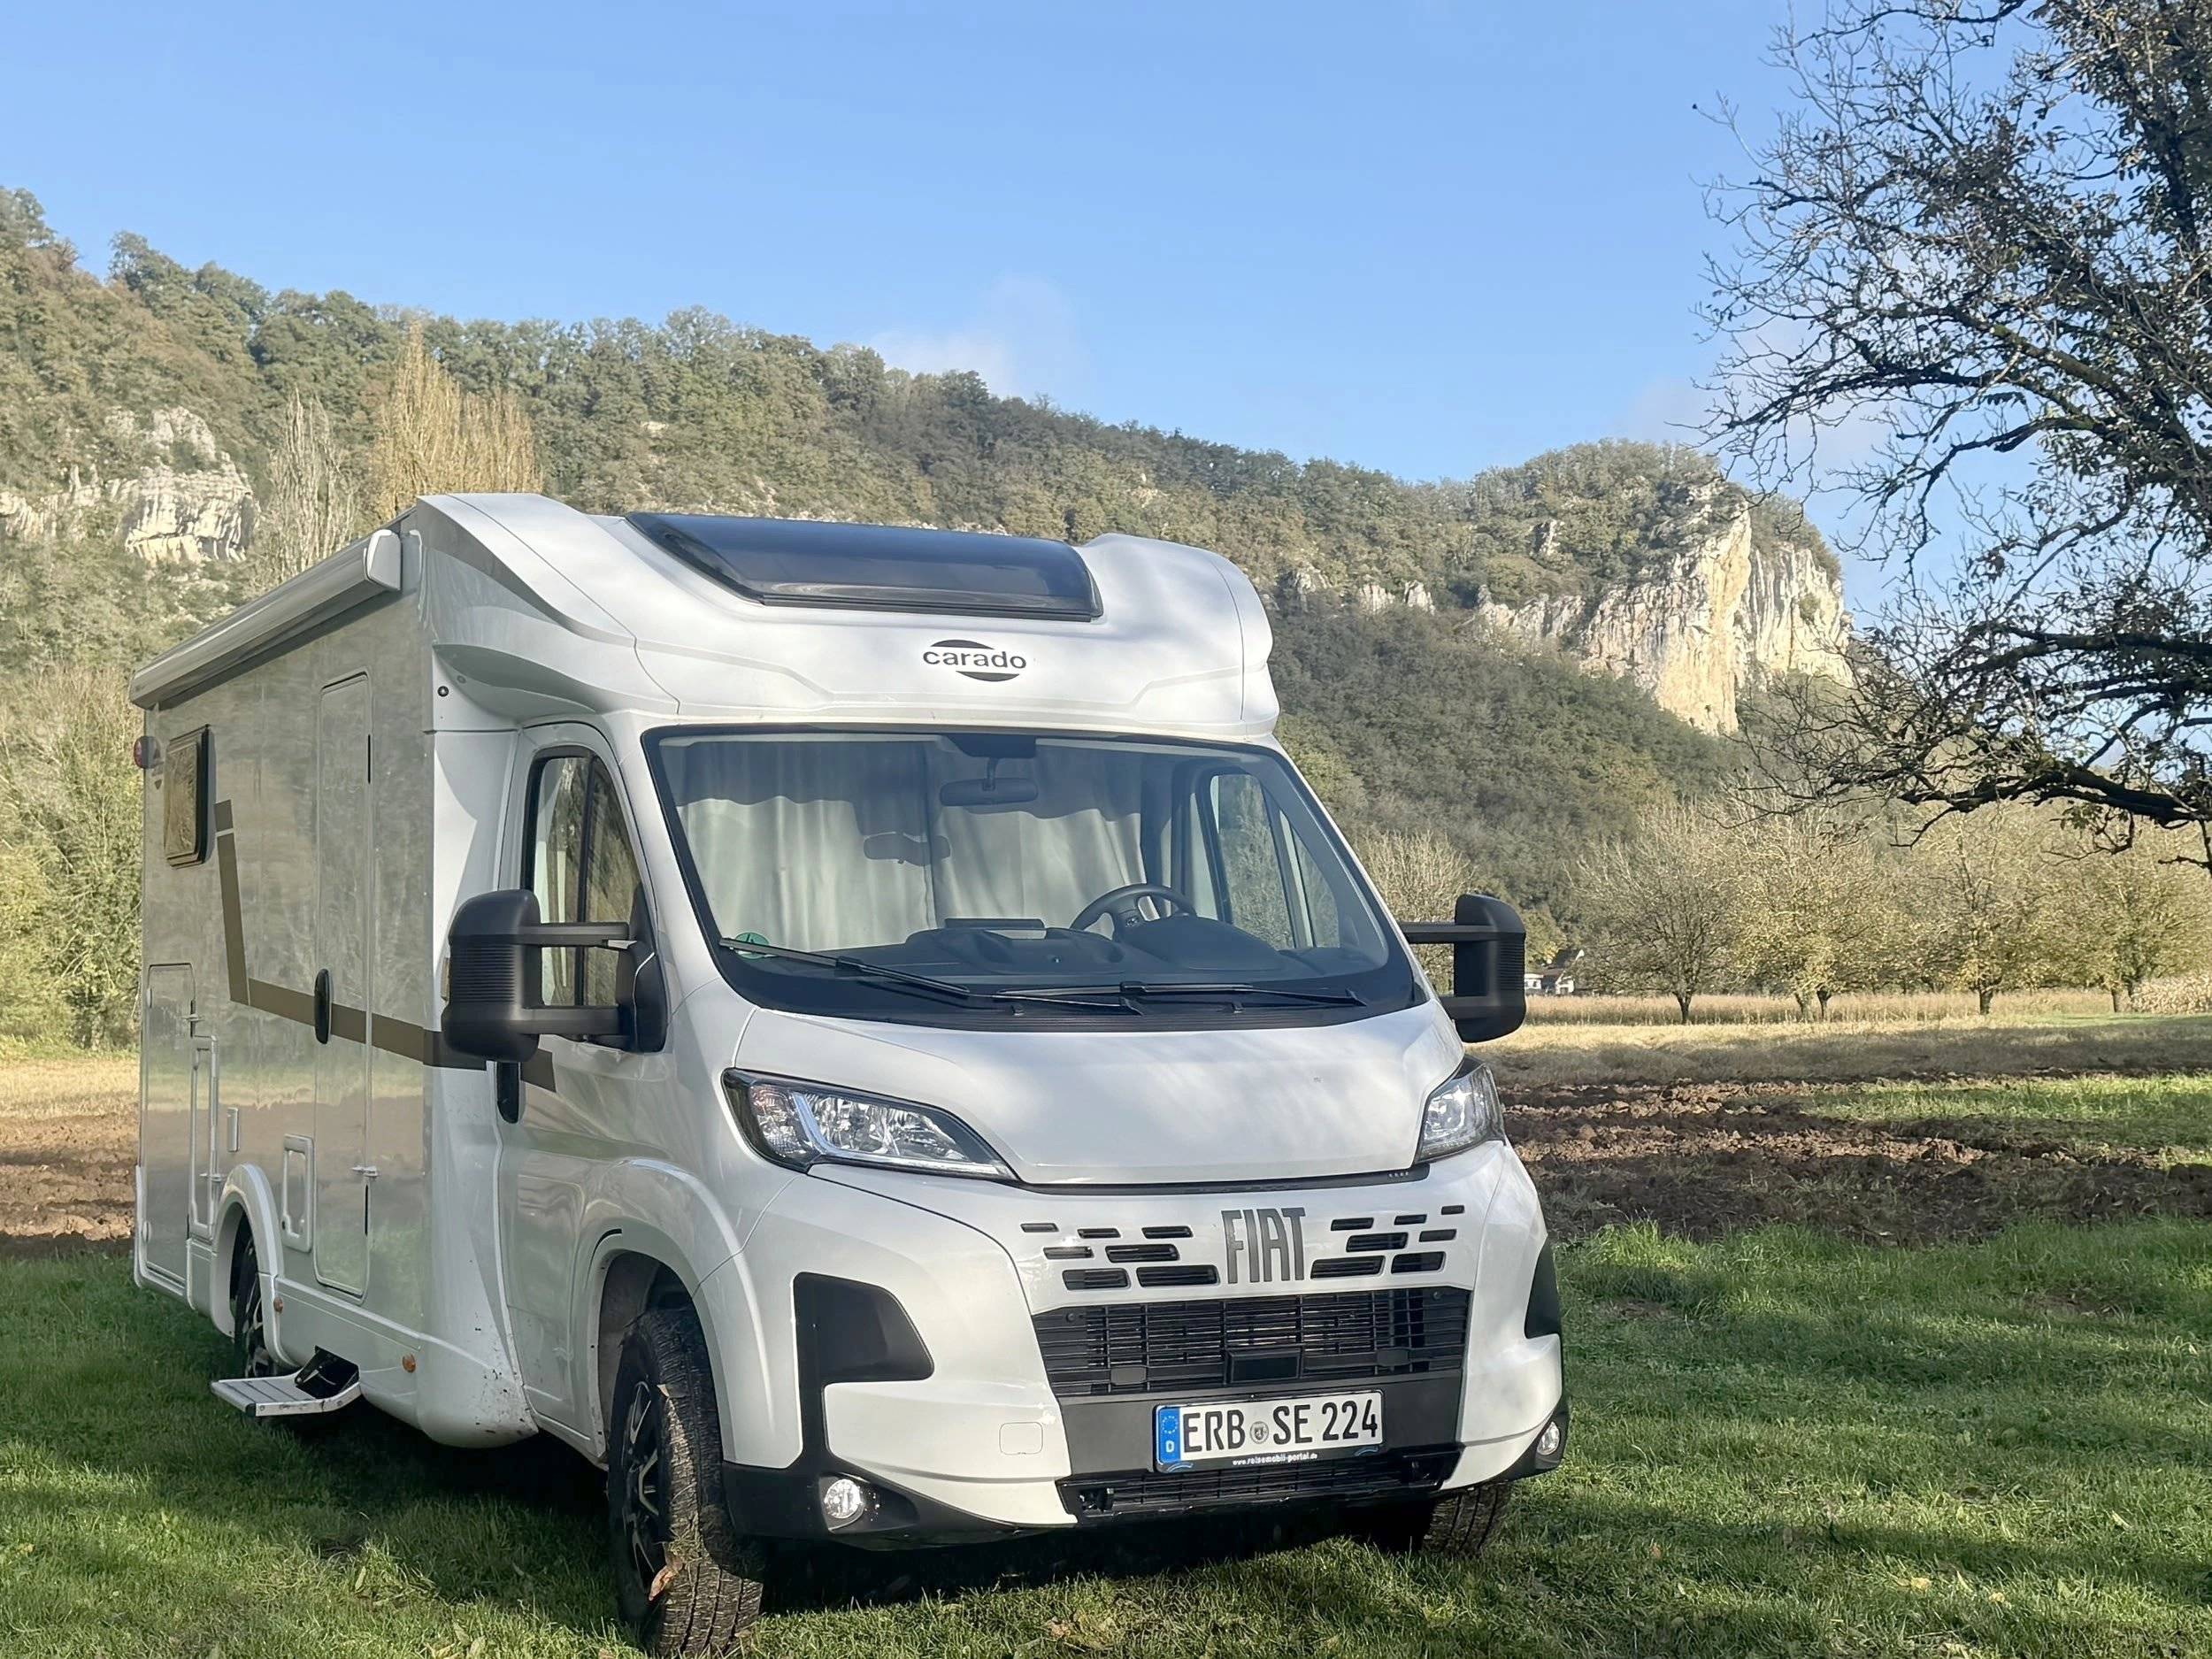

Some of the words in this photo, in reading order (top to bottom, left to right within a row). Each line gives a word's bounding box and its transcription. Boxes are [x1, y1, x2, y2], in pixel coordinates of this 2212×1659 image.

[923, 651, 1027, 669] carado
[1221, 1207, 1306, 1284] FIAT
[1183, 1409, 1246, 1453] ERB
[1272, 1404, 1313, 1445] SE
[1322, 1399, 1378, 1440] 224
[1165, 1440, 1175, 1453] D
